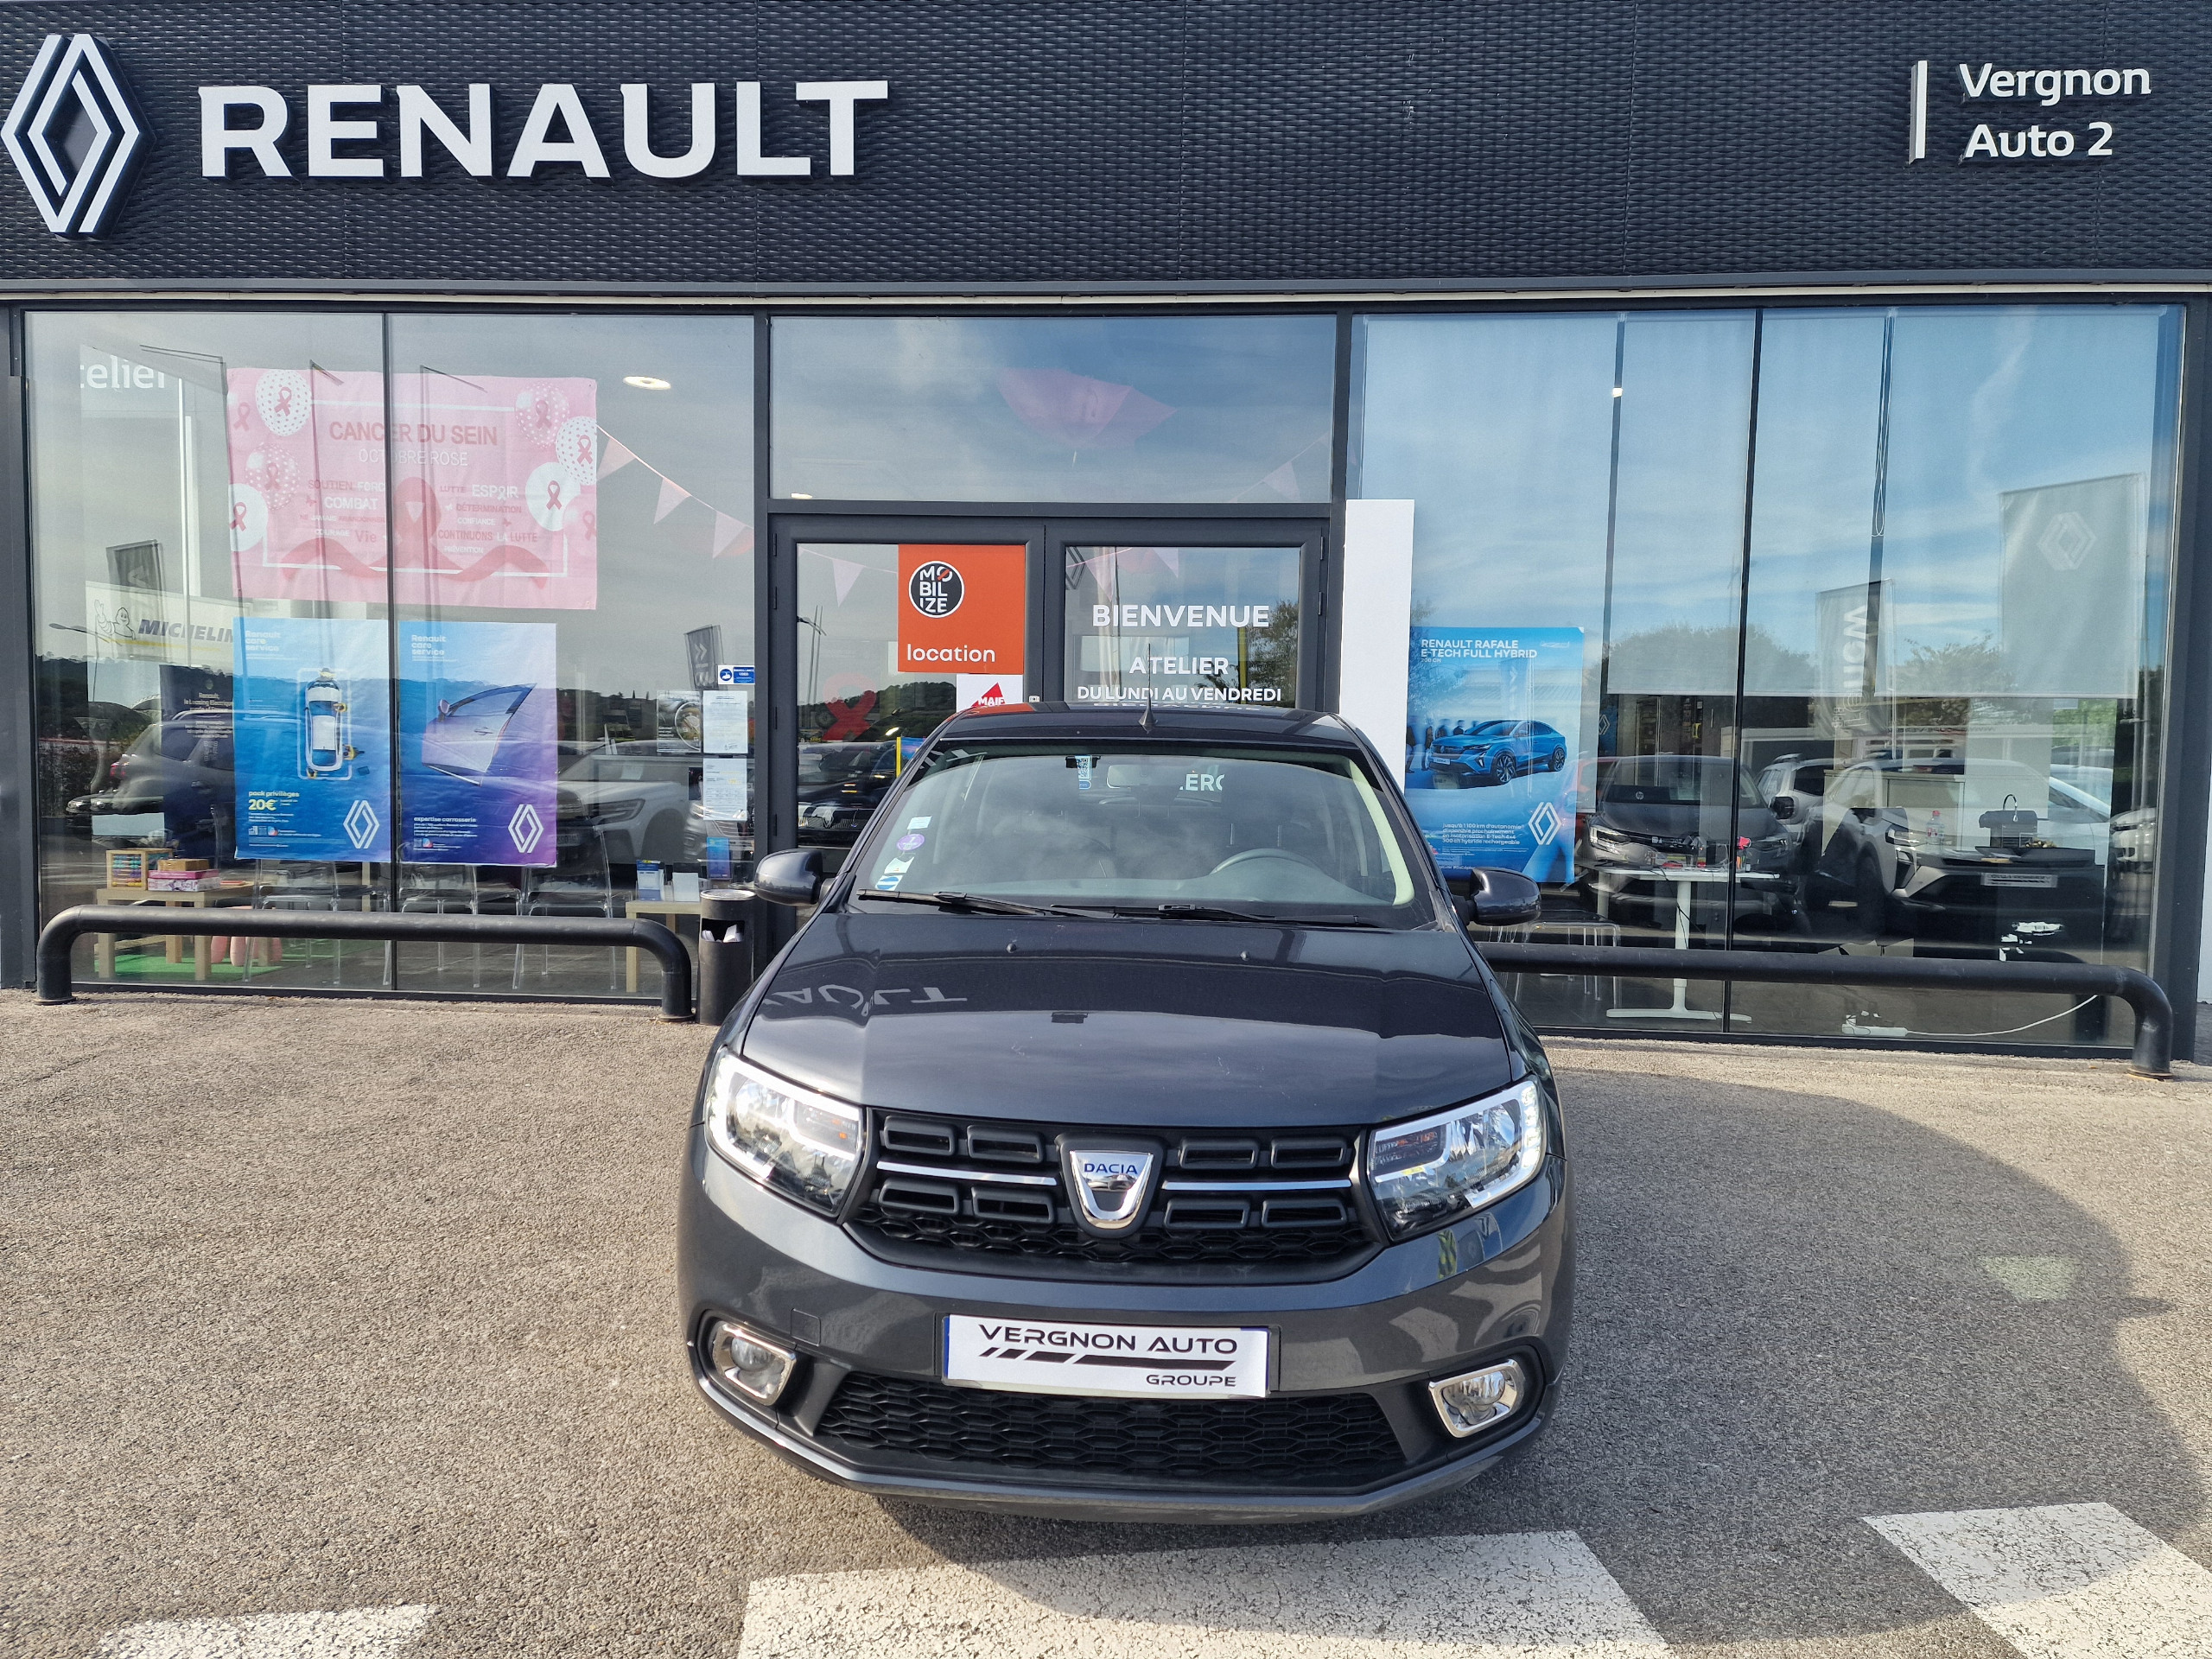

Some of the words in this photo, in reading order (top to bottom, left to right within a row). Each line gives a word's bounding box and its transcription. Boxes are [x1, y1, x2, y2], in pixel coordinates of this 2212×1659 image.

[1959, 63, 2152, 106] Vergnon
[198, 79, 889, 179] RENAULT
[1964, 124, 2075, 157] Auto
[2088, 121, 2113, 156] 2
[329, 421, 411, 443] CANCER
[416, 423, 446, 444] DU
[451, 425, 498, 446] SEIN
[359, 448, 426, 464] OCTOBRE
[430, 450, 468, 466] ROSE
[308, 479, 353, 491] SOUTIEN
[357, 481, 386, 492] FORC
[440, 485, 467, 493] LUTTE
[323, 496, 378, 510] COMBAT
[456, 503, 522, 513] DÉTERMINATION
[457, 517, 496, 526] CONFIANCE
[355, 530, 377, 543] Vie
[437, 529, 493, 541] CONTINUONS
[497, 532, 508, 542] LA
[510, 532, 537, 543] LUTTE
[919, 582, 948, 597] BIL
[919, 597, 948, 613] IZE
[1092, 605, 1269, 627] BIENVENUE
[1421, 639, 1472, 649] RENAULT
[1475, 639, 1518, 649] RAFALE
[907, 643, 995, 663] location
[1421, 649, 1461, 658] E-TECH
[1463, 649, 1491, 658] FULL
[1494, 649, 1538, 658] HYBRID
[1128, 657, 1229, 675] ATELIER
[1077, 686, 1102, 700] DU
[1105, 686, 1158, 700] LUNDI
[1162, 687, 1187, 701] AU
[1191, 687, 1281, 702] VENDREDI
[978, 696, 1005, 707] MAIF
[248, 798, 276, 810] 20€
[1084, 1163, 1138, 1174] DACIA
[977, 1324, 1136, 1351] VERGNON
[1147, 1336, 1238, 1354] AUTO
[1146, 1373, 1237, 1387] GROUPE
